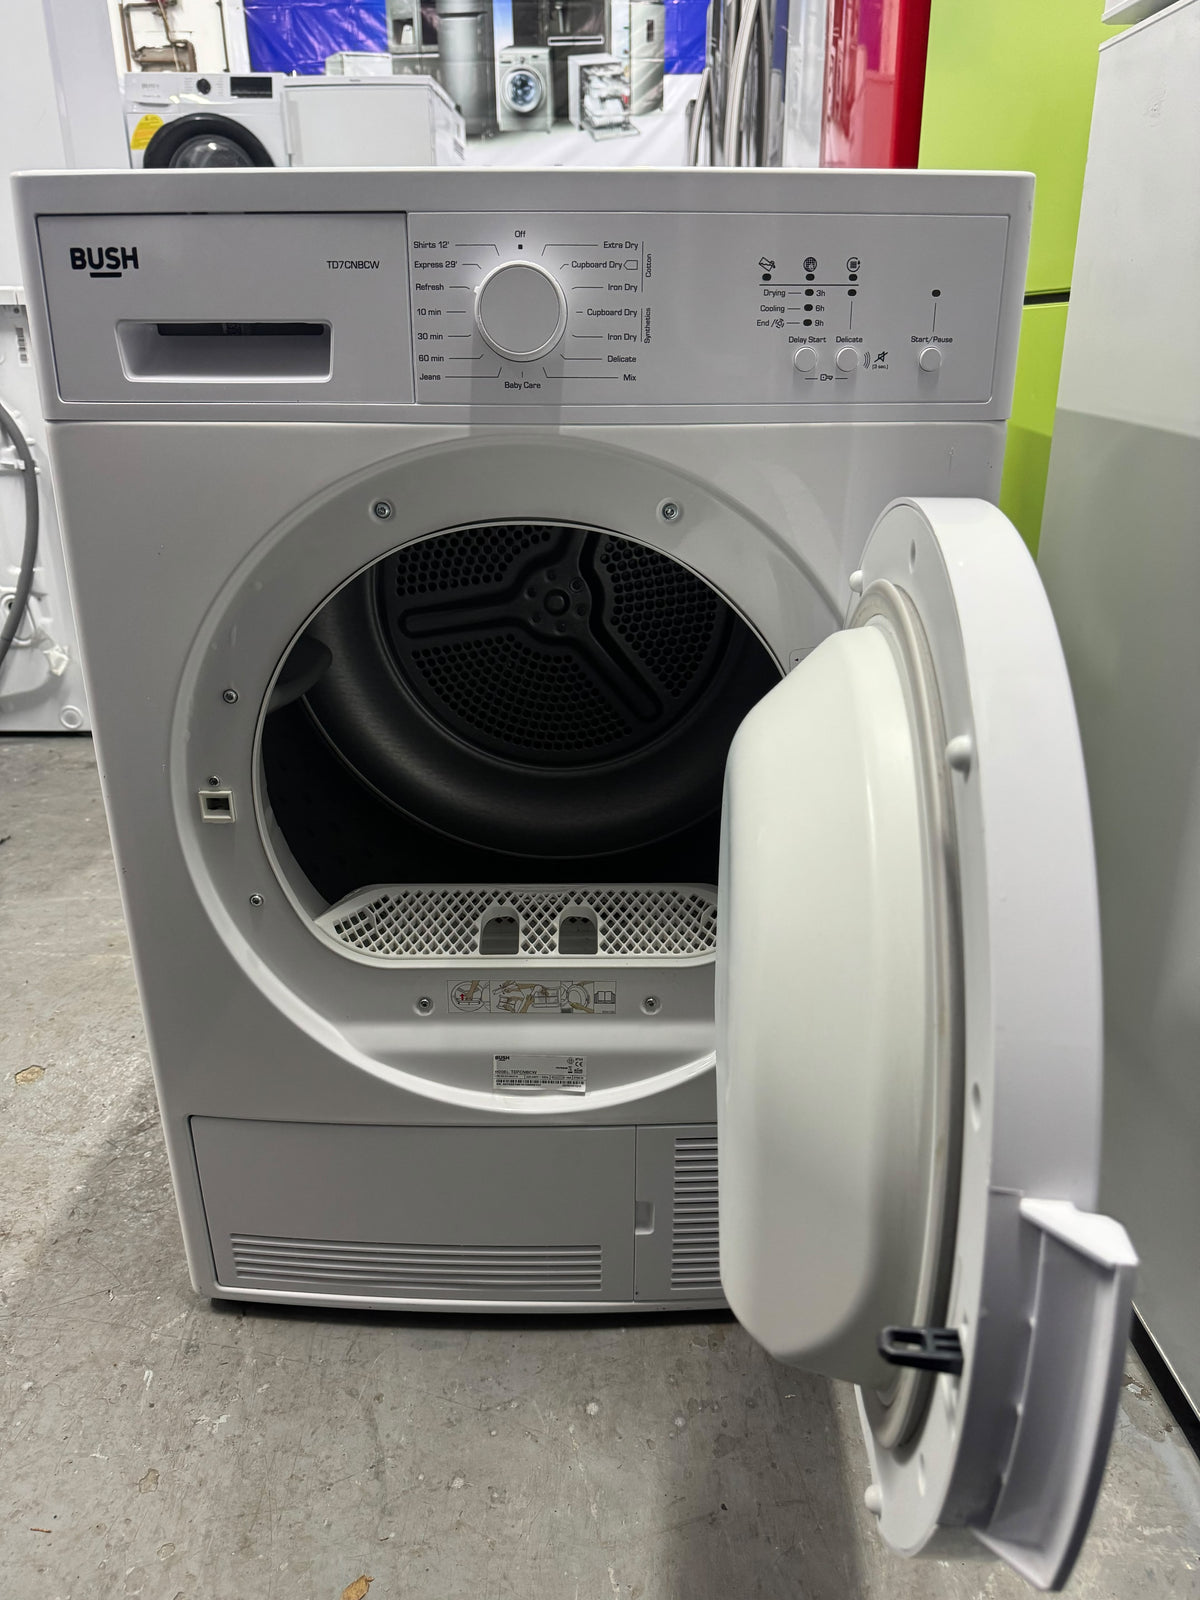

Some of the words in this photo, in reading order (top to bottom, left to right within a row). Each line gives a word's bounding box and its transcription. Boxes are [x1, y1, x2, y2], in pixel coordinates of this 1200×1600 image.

[514, 230, 526, 238] Off
[413, 241, 436, 249] Shirts
[438, 241, 450, 249] 12'
[603, 241, 623, 249] Extra
[625, 241, 639, 250] Dry
[69, 246, 139, 271] BUSH
[326, 260, 380, 269] TD7CNBCW
[414, 261, 444, 270] Express
[571, 261, 607, 270] Cupboard
[609, 261, 623, 270] Dry
[415, 283, 444, 291] Refresh
[607, 283, 622, 291] Iron
[624, 283, 638, 292] Dry
[763, 289, 786, 298] Drying
[816, 289, 826, 297] 3h
[416, 308, 426, 316] 10
[428, 308, 442, 316] min
[587, 308, 622, 317] Cupboard
[624, 308, 638, 317] Dry
[760, 305, 785, 314] Cooling
[756, 319, 770, 327] End
[814, 319, 824, 327] 9h
[607, 333, 622, 341] Iron
[624, 333, 637, 342] Dry
[788, 336, 807, 344] Delay
[808, 336, 827, 344] Start
[910, 336, 953, 344] Start/Pause
[418, 354, 429, 362] 60
[431, 354, 444, 362] min
[607, 355, 637, 363] Delicate
[419, 373, 441, 381] Jeans
[504, 381, 522, 390] Baby
[524, 381, 541, 389] Care
